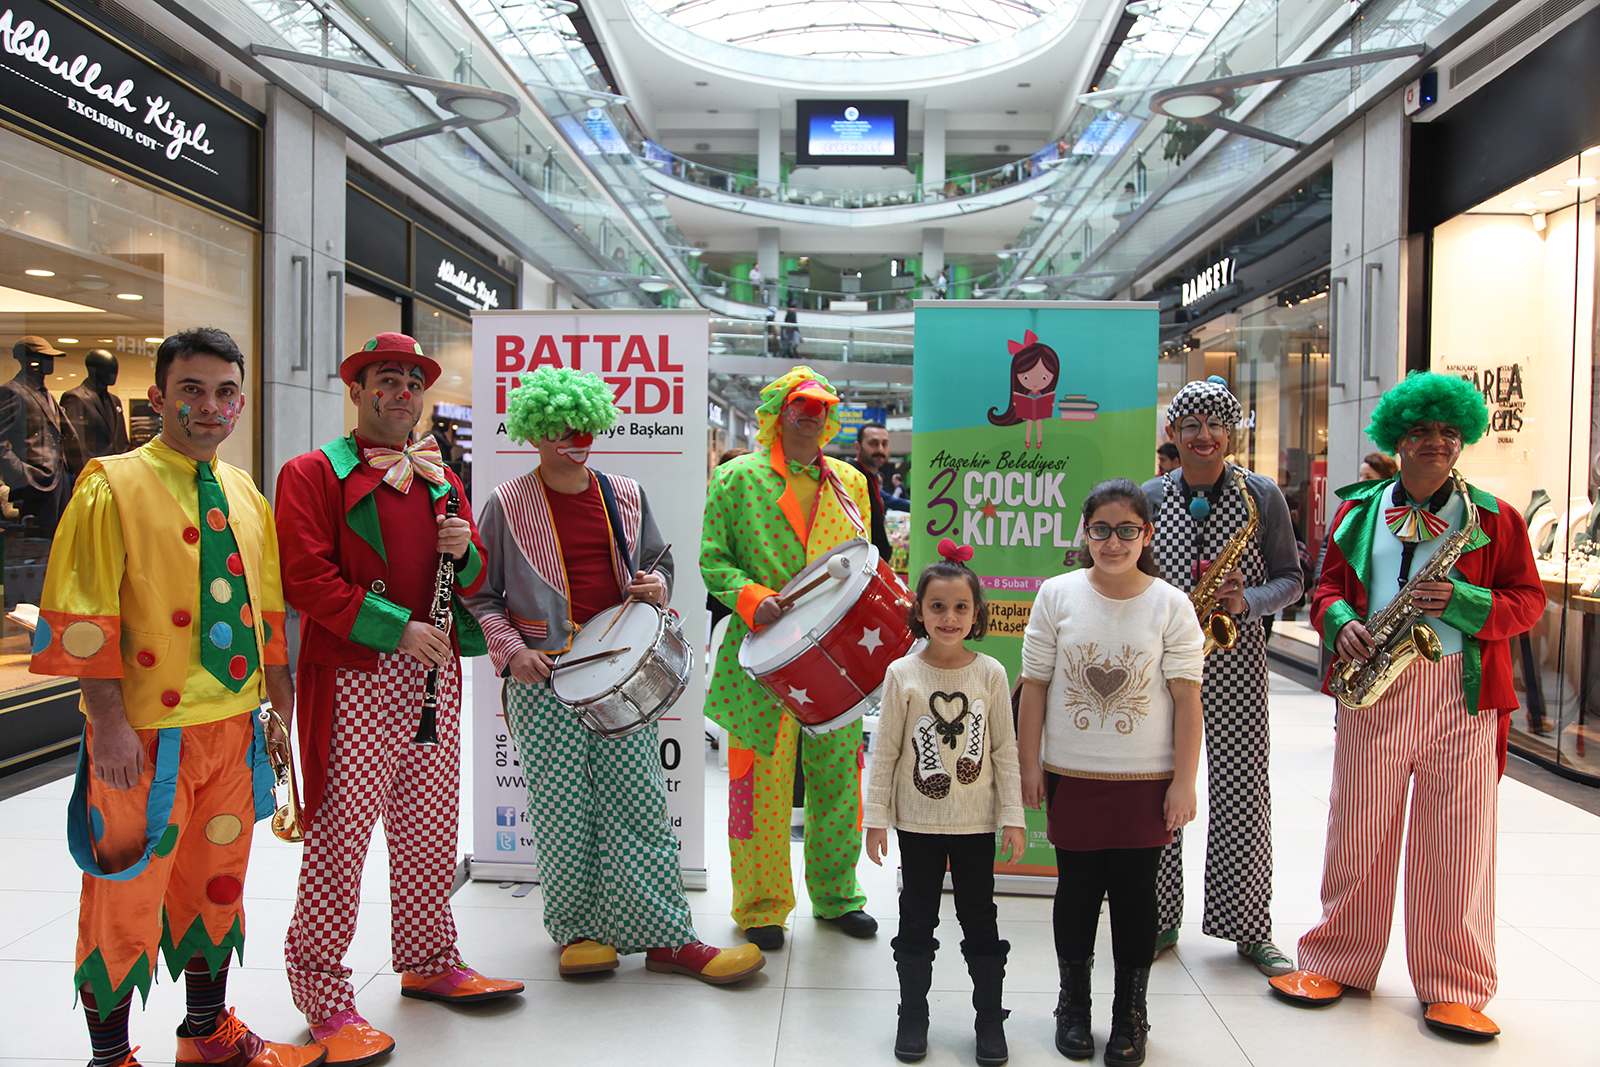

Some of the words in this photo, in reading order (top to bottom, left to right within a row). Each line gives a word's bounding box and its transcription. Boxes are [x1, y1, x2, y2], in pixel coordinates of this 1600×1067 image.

[0, 9, 137, 113] Abdullah
[67, 97, 134, 140] EXCLUSIVE
[135, 131, 159, 150] CUT
[1182, 257, 1230, 306] RAMSEY
[496, 335, 683, 373] BATTAL
[1461, 363, 1524, 405] ARLA
[630, 421, 684, 439] Başkanı
[929, 449, 990, 472] Ataşehir
[996, 450, 1070, 477] Belediyesi
[963, 470, 1067, 510] ÇOCUK
[994, 578, 1000, 588] 8
[1001, 578, 1029, 589] Şubat
[495, 734, 507, 767] 0216
